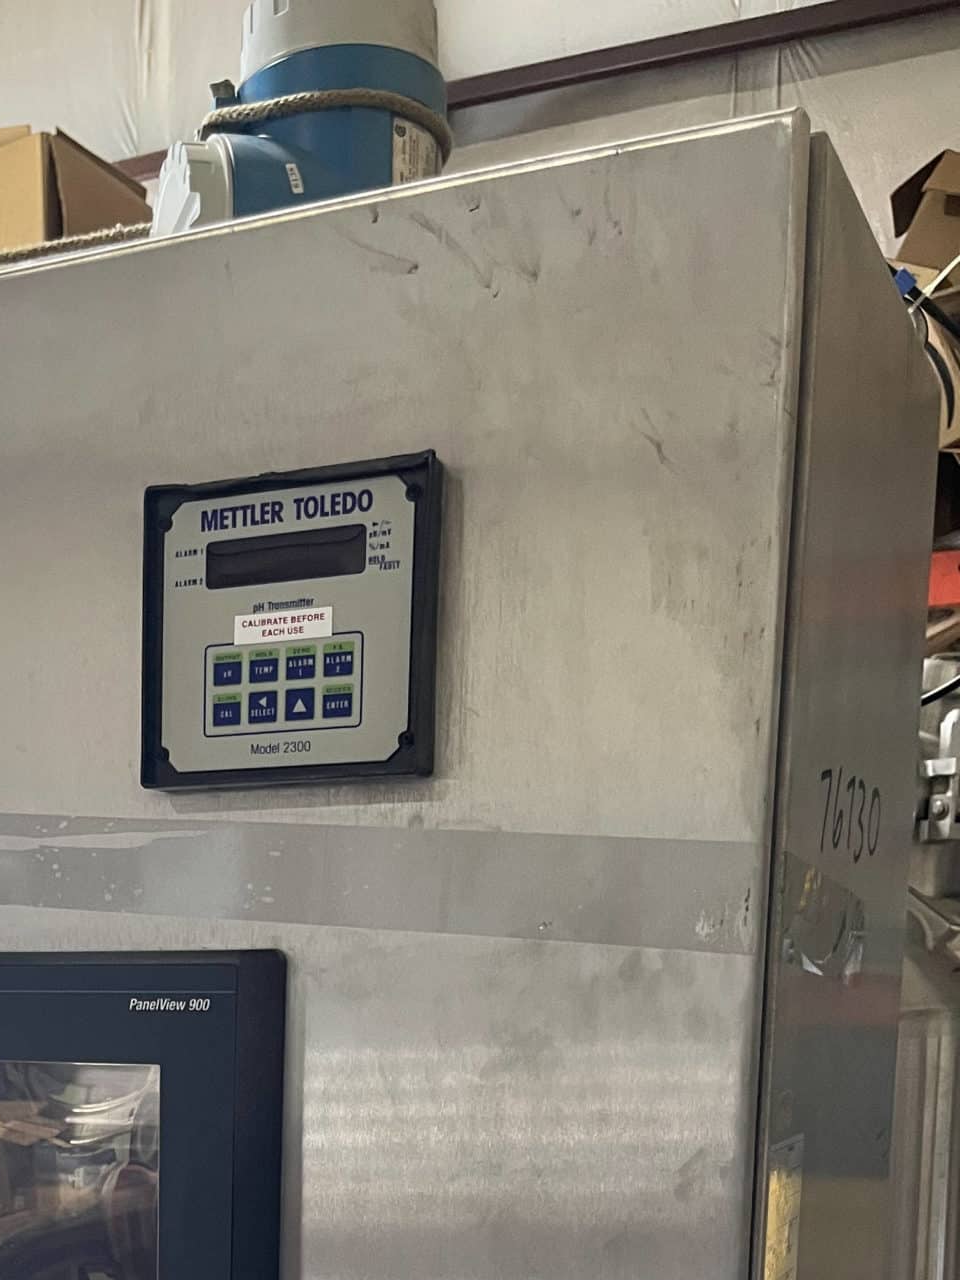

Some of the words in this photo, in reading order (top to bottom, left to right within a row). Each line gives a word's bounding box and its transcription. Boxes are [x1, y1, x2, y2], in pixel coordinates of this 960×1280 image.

[201, 500, 284, 532] METTLER
[294, 489, 373, 520] TOLEDO
[175, 549, 197, 558] ALARM
[175, 578, 197, 587] ALARM
[253, 602, 264, 614] pH
[268, 598, 315, 611] Transmitter
[241, 616, 289, 628] CALIBRATE
[291, 612, 326, 624] BEFORE
[261, 628, 285, 638] EACH
[287, 626, 304, 635] USE
[288, 658, 313, 667] ALARM
[326, 655, 352, 664] ALARM
[255, 666, 273, 675] TEMP
[251, 707, 275, 717] SELECT
[250, 742, 280, 755] Model
[283, 741, 311, 753] 2300
[129, 998, 186, 1011] PanelView
[188, 998, 210, 1011] 900
